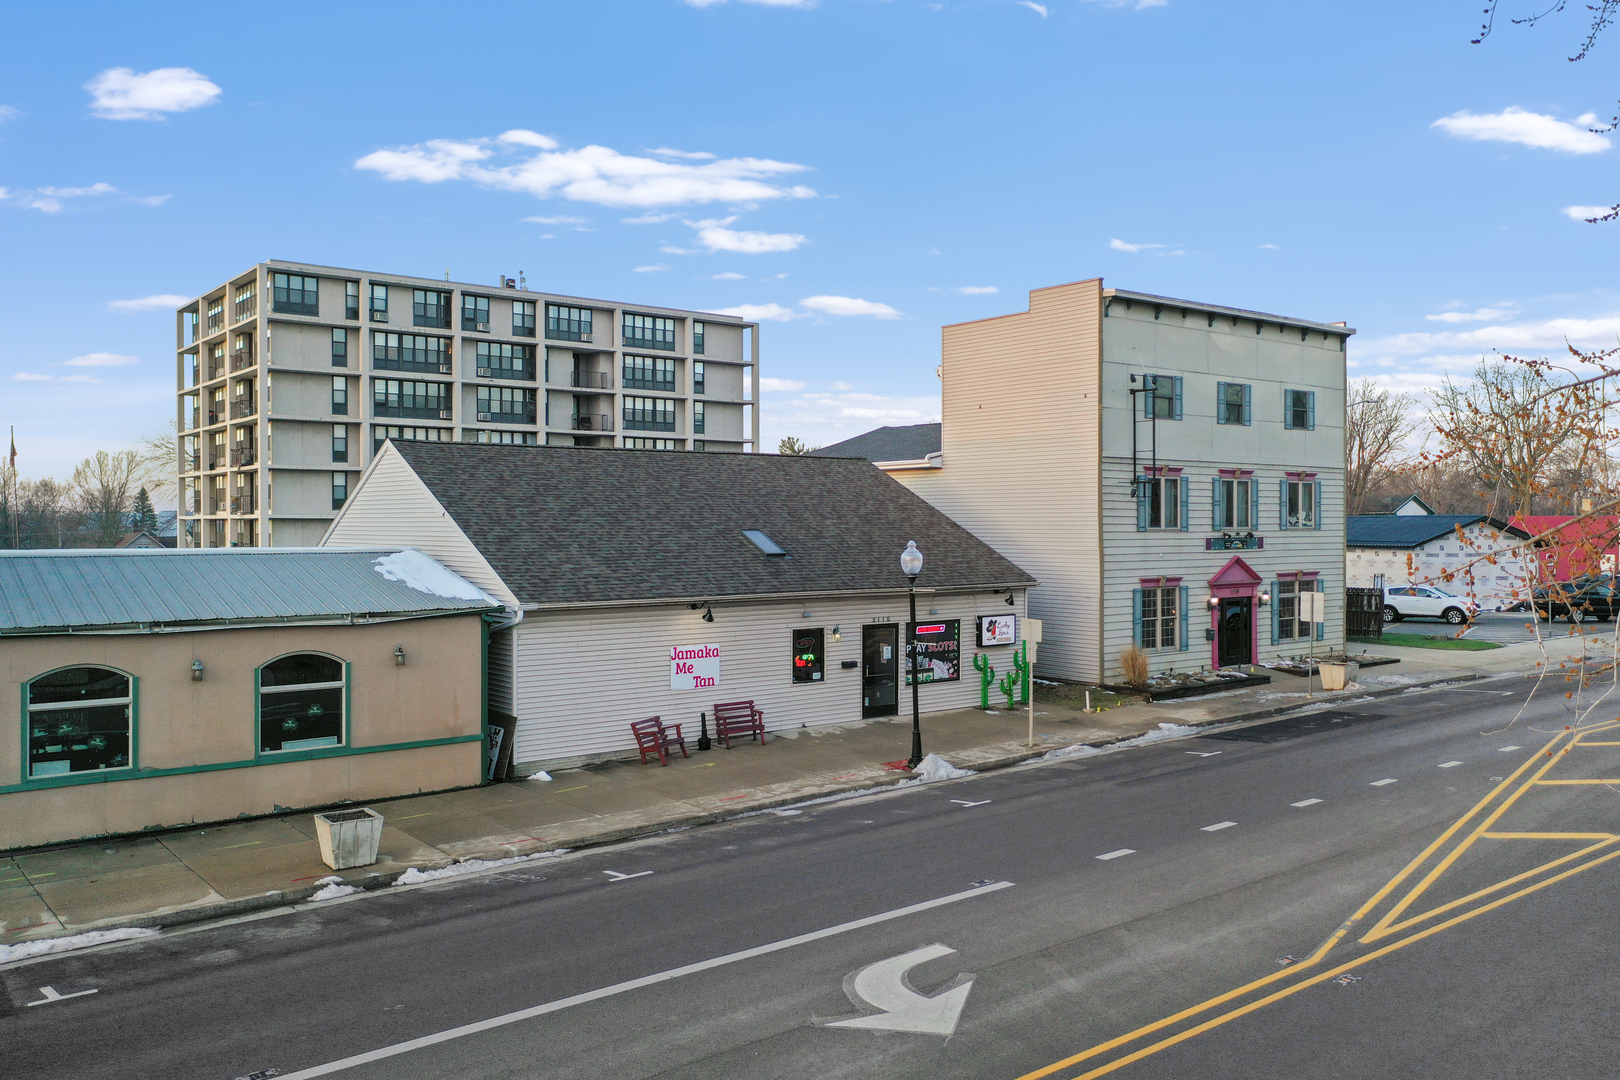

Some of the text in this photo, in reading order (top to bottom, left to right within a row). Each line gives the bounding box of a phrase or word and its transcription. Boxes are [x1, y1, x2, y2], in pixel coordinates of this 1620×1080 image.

[671, 645, 719, 660] Jamaka
[906, 643, 926, 653] PAY
[675, 662, 694, 674] Me
[693, 675, 715, 687] Tan
